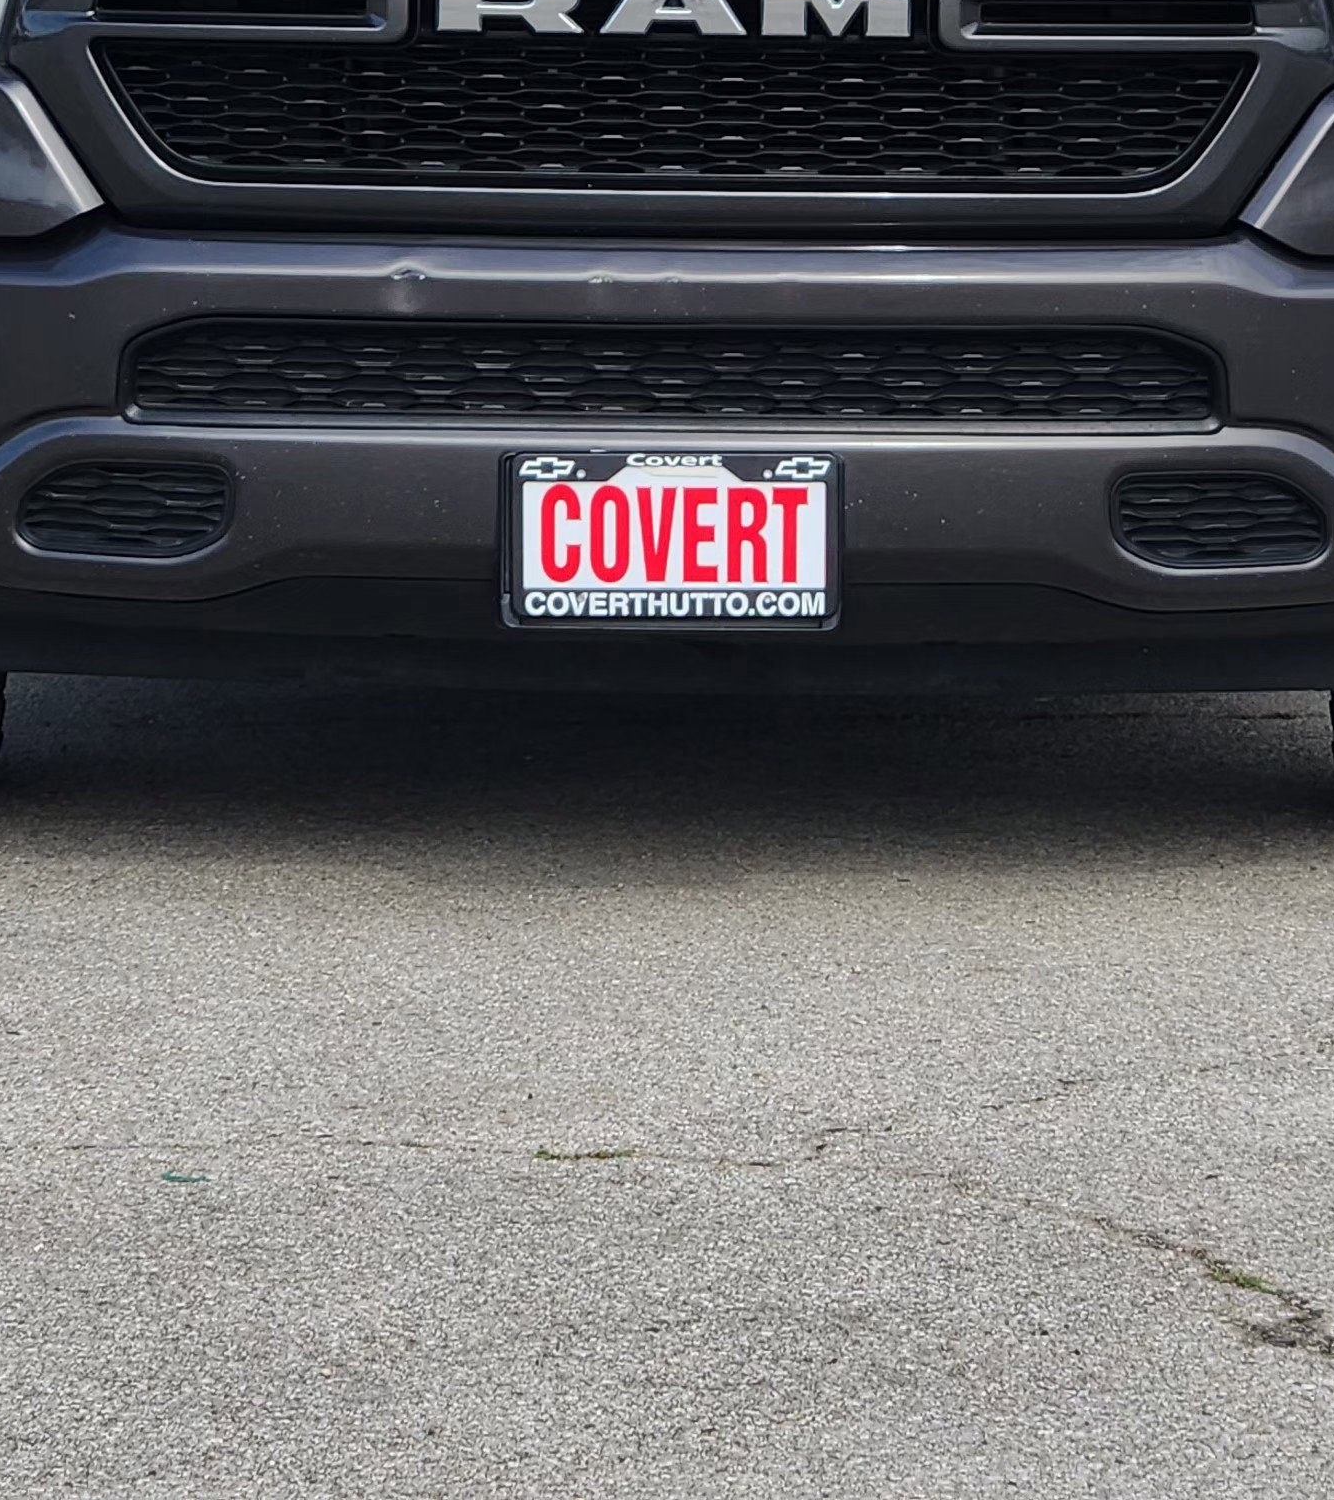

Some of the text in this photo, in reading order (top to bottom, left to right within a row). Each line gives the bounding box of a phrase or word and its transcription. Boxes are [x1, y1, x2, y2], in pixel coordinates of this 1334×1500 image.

[626, 453, 723, 468] Covert
[540, 483, 809, 583] COVERT
[524, 591, 826, 618] COVERTHUTTO.COM
